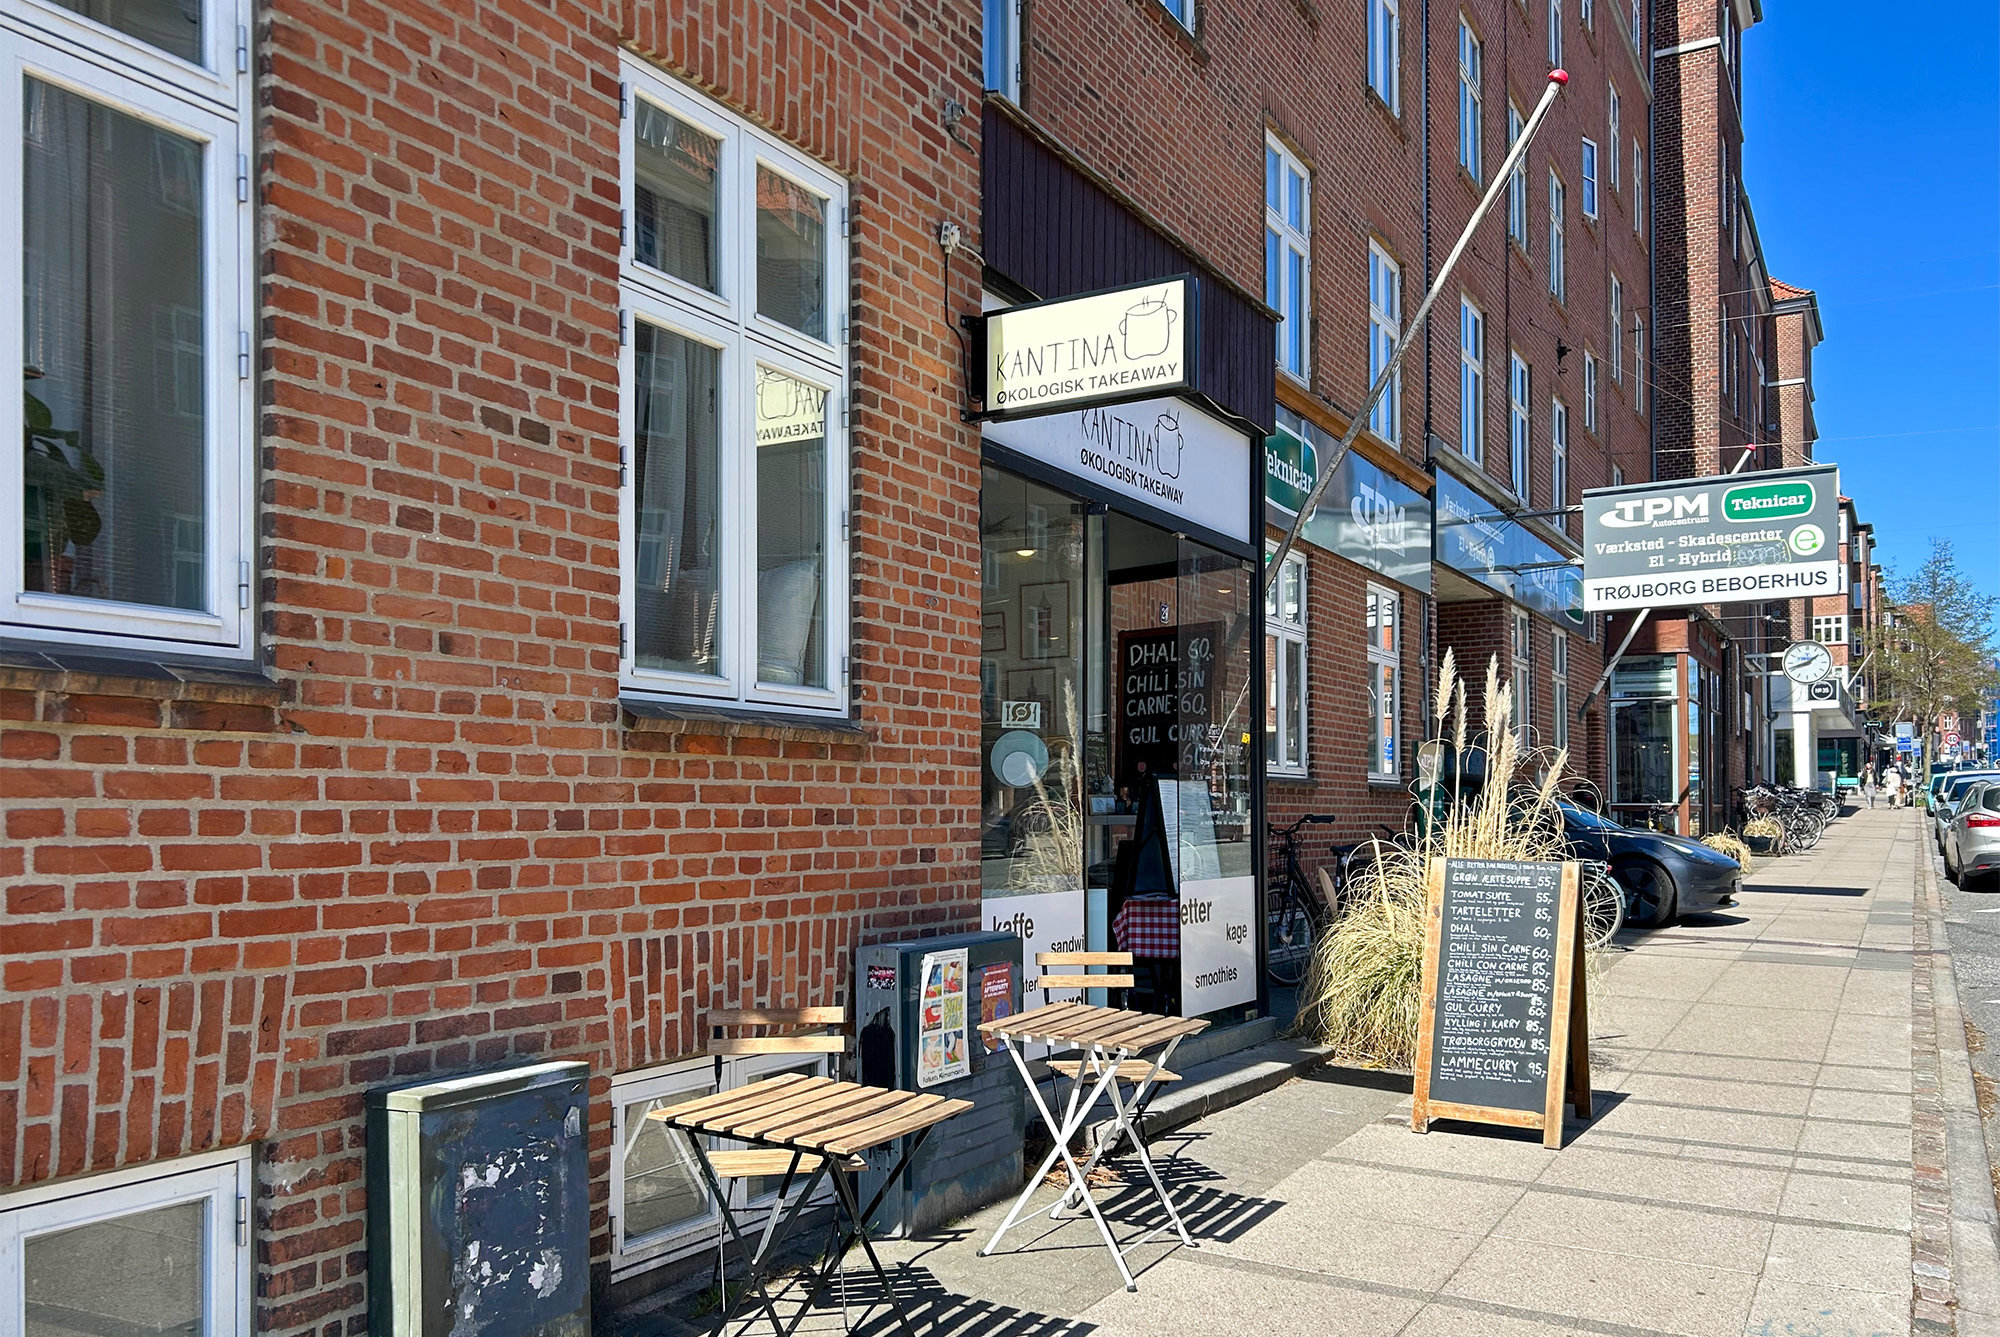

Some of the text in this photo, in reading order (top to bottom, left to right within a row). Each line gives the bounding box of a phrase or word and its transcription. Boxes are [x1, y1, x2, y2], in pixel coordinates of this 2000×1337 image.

[997, 334, 1117, 381] KANTINA
[997, 362, 1177, 404] ØKOLOGISK TAKEAWAY
[1081, 408, 1154, 470] KANTINA
[1081, 448, 1183, 505] ØKOLOGISK TAKEAWAY
[1265, 447, 1312, 494] eknicar
[1606, 493, 1709, 524] TPM
[1731, 493, 1806, 511] Teknicar
[1353, 482, 1405, 543] TPM
[1651, 516, 1709, 528] Autocentrum
[1594, 538, 1664, 555] Værksted
[1678, 529, 1783, 547] Skadescenter
[1649, 555, 1663, 567] El
[1678, 549, 1730, 566] Hybrid
[1593, 580, 1696, 600] TRØJBORG
[1702, 571, 1828, 593] BEBOERHUS
[1130, 726, 1160, 744] GUL
[1452, 872, 1478, 883] GRØN
[1450, 906, 1521, 918] TARTELETTER
[1226, 922, 1247, 944] kage
[1450, 924, 1477, 934] DHAL
[1502, 944, 1531, 955] CARNE
[1476, 960, 1496, 970] CON
[1499, 961, 1529, 971] CARNE
[1195, 965, 1238, 989] smoothies
[1446, 973, 1493, 984] LASAGNE
[1444, 987, 1486, 997] LASAGNE
[1445, 1002, 1465, 1012] GUL
[1468, 1004, 1502, 1013] CURRY
[1492, 1020, 1520, 1029] KARRY
[1441, 1056, 1518, 1073] LAMMECURRY
